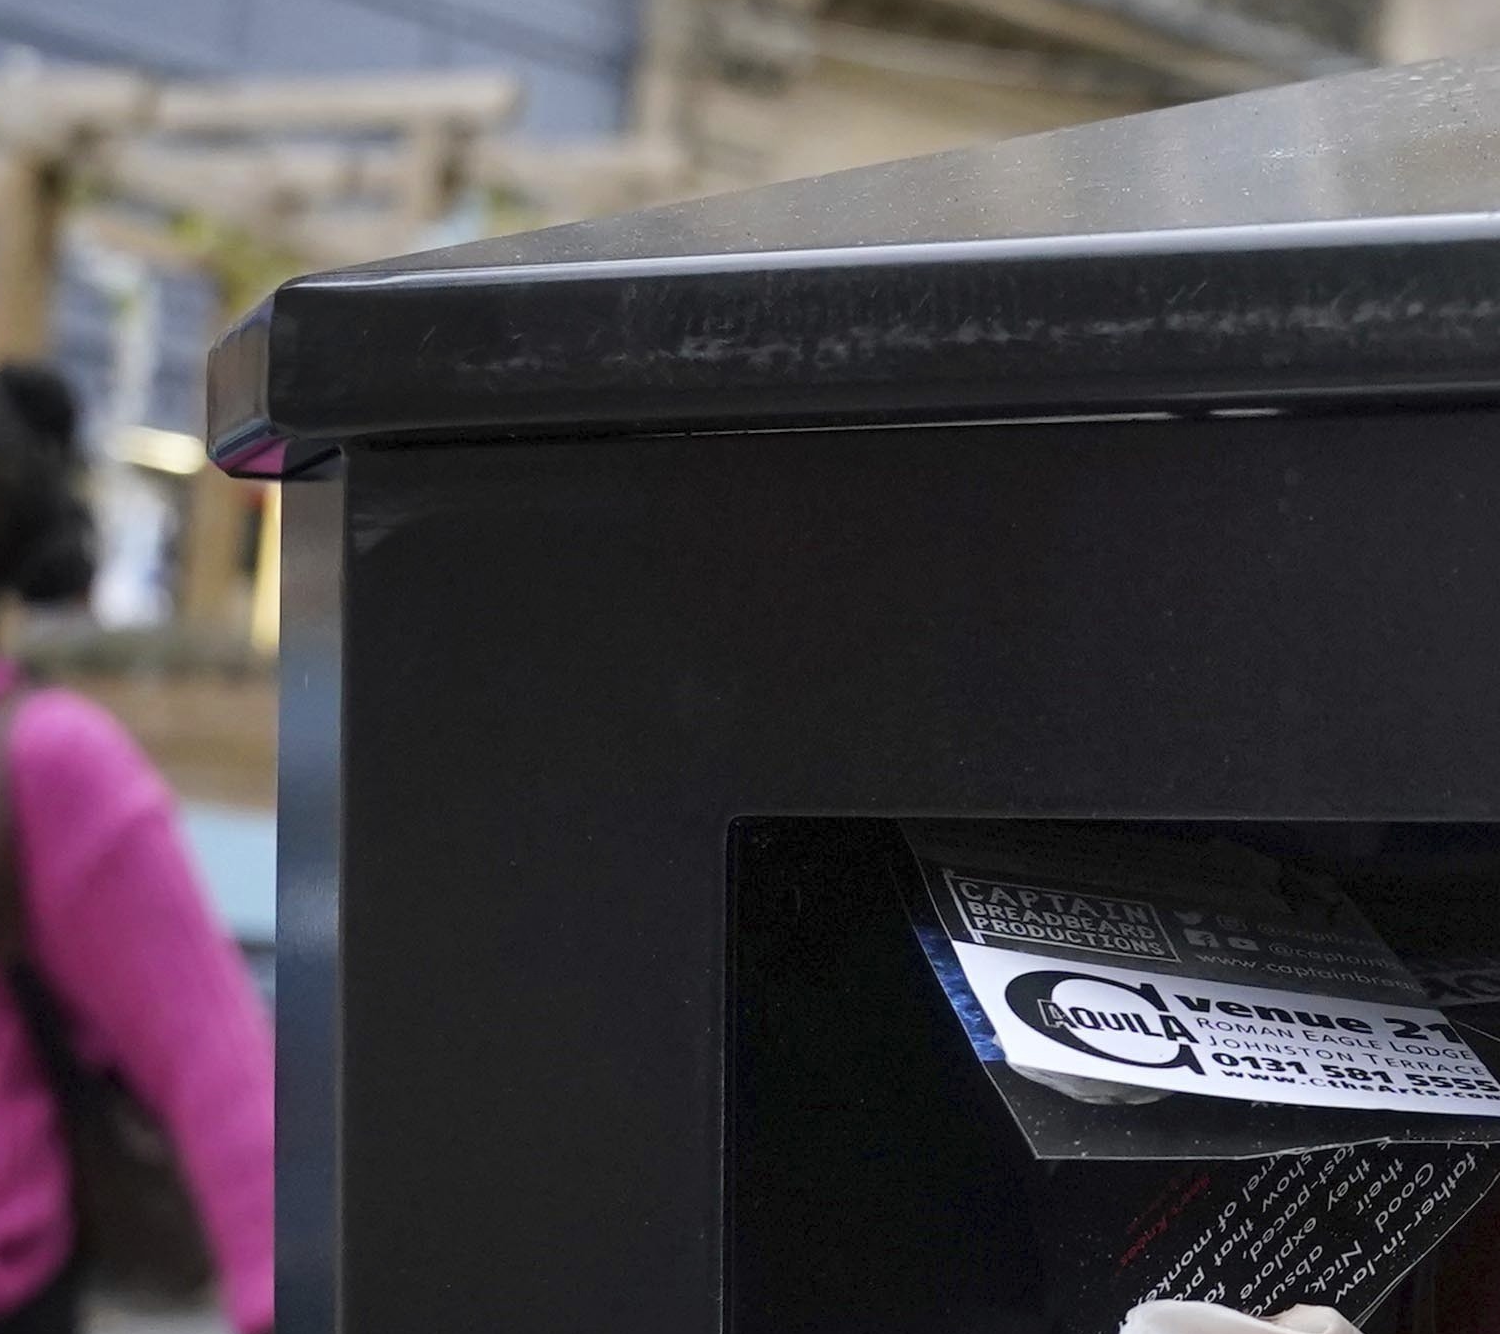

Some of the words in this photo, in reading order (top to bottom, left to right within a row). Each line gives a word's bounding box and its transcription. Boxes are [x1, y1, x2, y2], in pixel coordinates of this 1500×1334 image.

[961, 882, 1149, 924] CAPTAIN
[967, 900, 1156, 939] BREADBEARD
[973, 915, 1165, 956] PRODUCTIONS
[1037, 998, 1199, 1044] AQUILA
[1174, 994, 1374, 1034] venue
[1383, 1017, 1464, 1044] 21
[1197, 1017, 1294, 1038] ROMAN
[1305, 1030, 1381, 1050] EAGLE
[1390, 1041, 1474, 1060] LODGE
[1208, 1035, 1353, 1063] JOHNSTON
[1361, 1053, 1486, 1076] TERRACE
[1211, 1052, 1307, 1075] 0131
[1320, 1064, 1394, 1084] 581
[1241, 1156, 1281, 1202] rrel
[1263, 1151, 1312, 1213] show
[1327, 1158, 1371, 1212] they
[1356, 1158, 1404, 1216] their
[1374, 1162, 1434, 1233] Good
[1218, 1201, 1237, 1233] of
[1242, 1146, 1355, 1263] fast-paced,
[1335, 1152, 1477, 1304] father-in-law
[1213, 1218, 1254, 1267] that
[1240, 1217, 1317, 1300] explore
[1304, 1240, 1363, 1294] Nick,
[1203, 1282, 1226, 1304] fa
